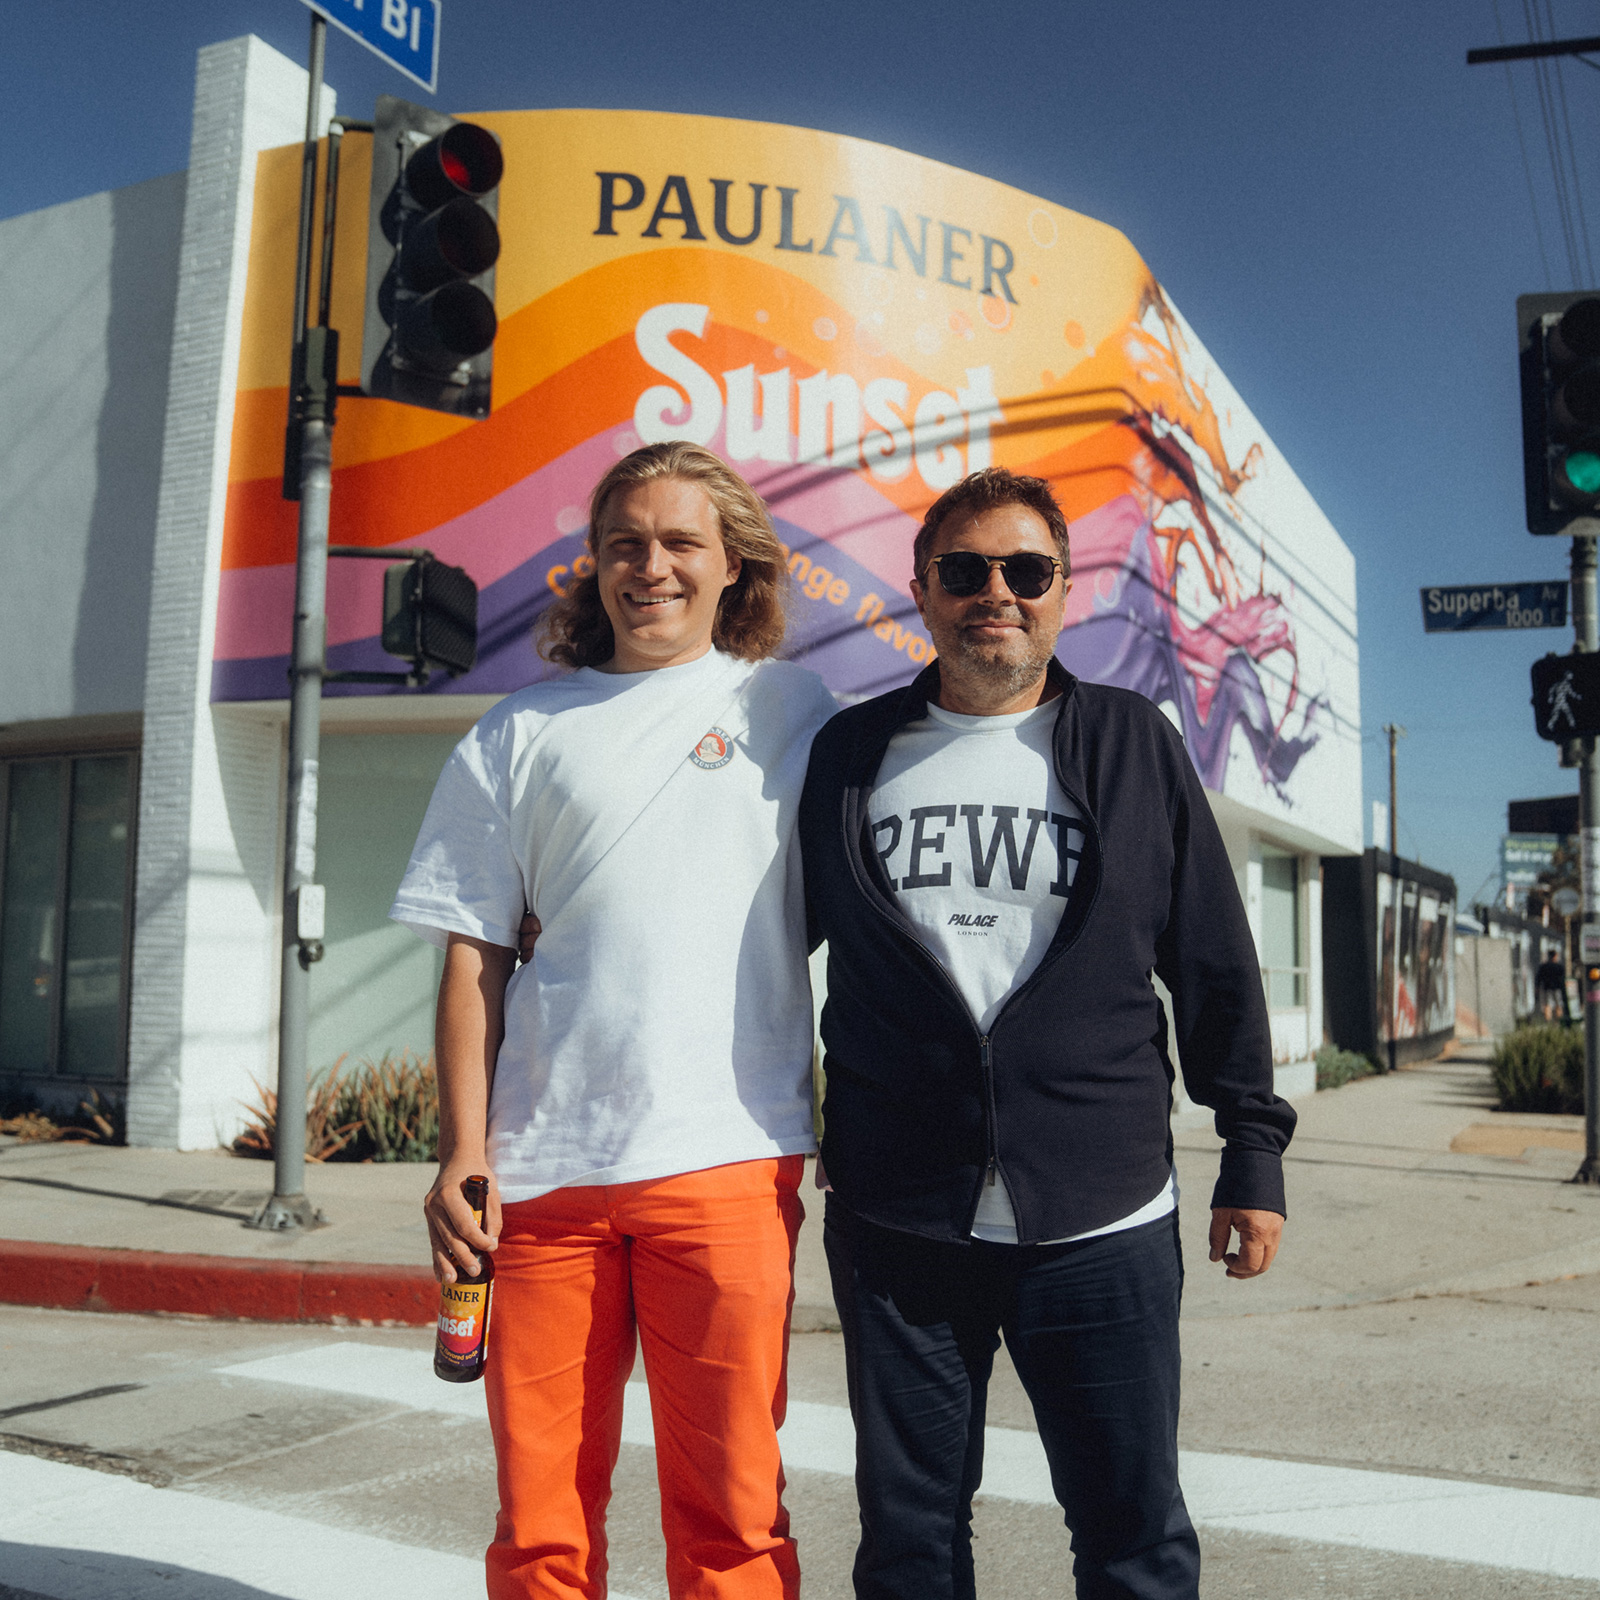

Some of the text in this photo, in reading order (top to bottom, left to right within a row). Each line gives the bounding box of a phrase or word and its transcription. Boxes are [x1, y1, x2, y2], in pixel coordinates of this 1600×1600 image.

[593, 171, 1019, 305] PAULANER
[634, 302, 1006, 493] Sunset
[1428, 588, 1520, 617] Superba
[1506, 609, 1544, 627] 1000
[947, 913, 999, 928] PALACE
